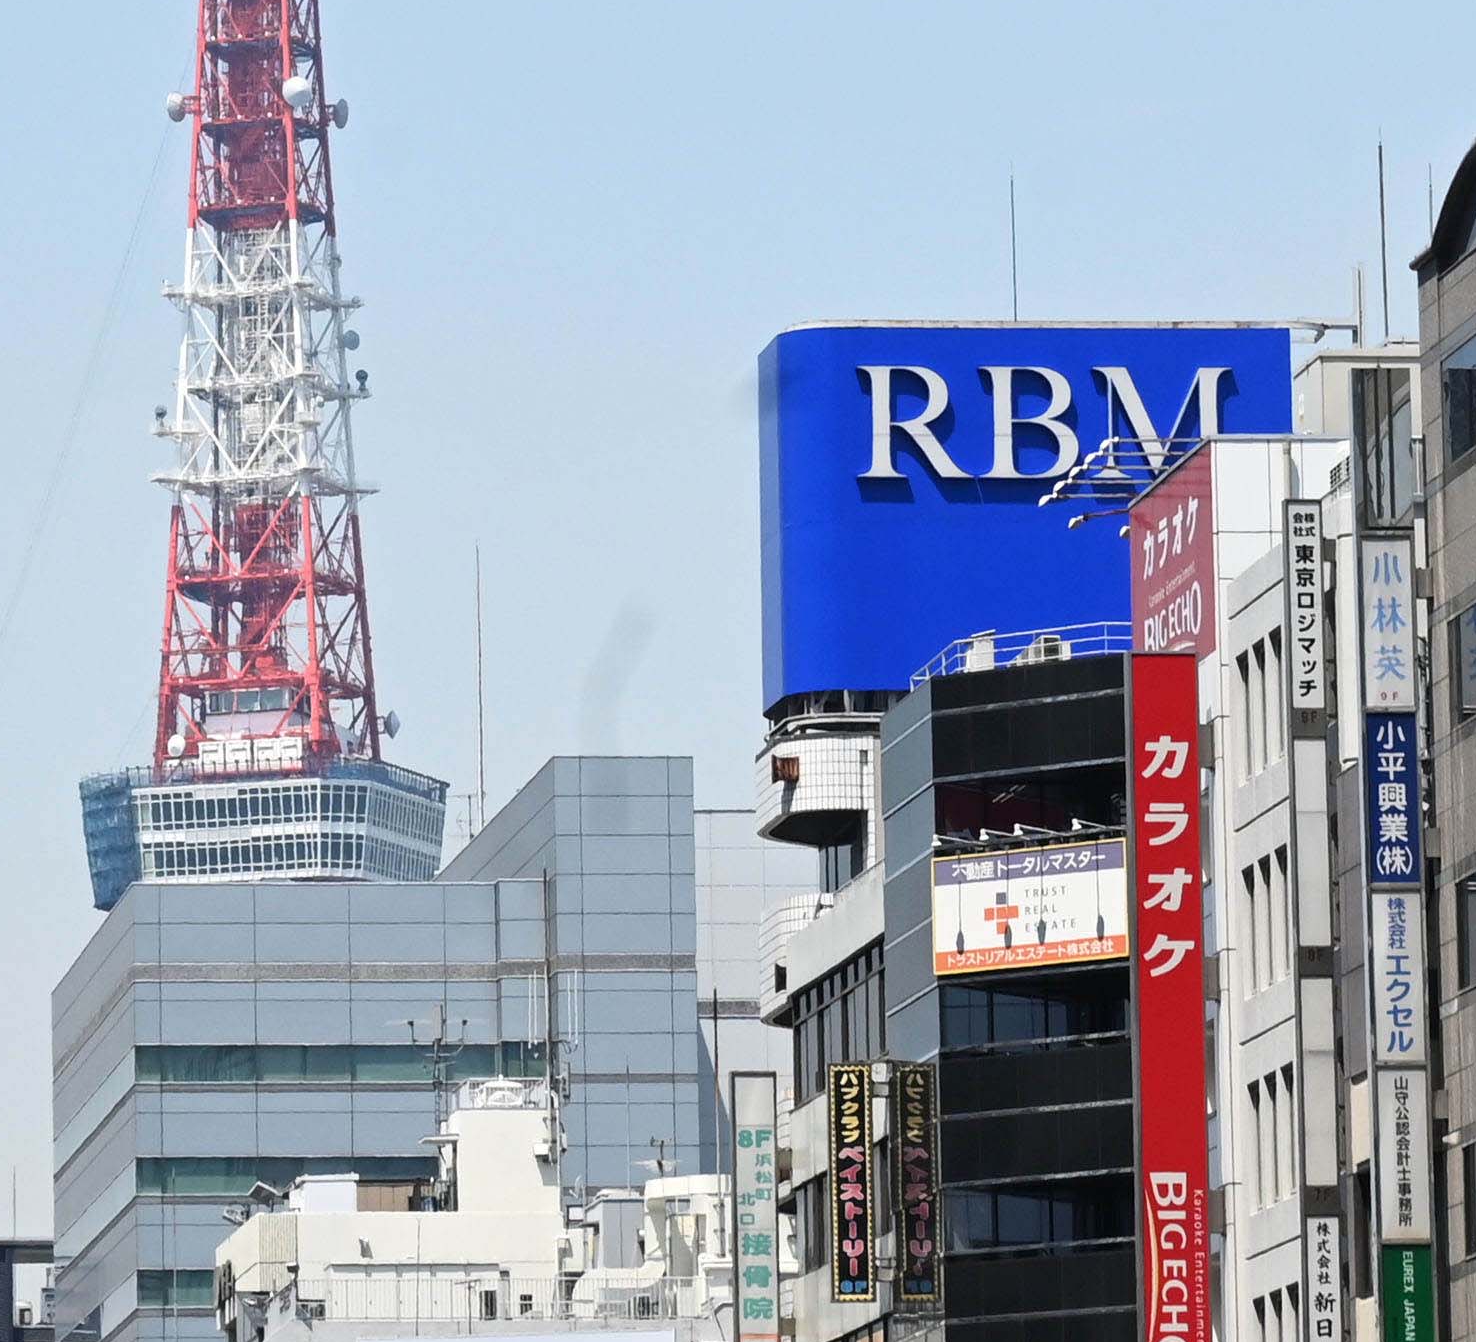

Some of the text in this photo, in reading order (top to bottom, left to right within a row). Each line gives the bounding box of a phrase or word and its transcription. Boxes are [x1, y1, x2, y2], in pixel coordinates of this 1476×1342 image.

[855, 365, 1235, 479] RBM
[1143, 496, 1199, 581] カラオケ
[1169, 580, 1201, 639] ECHO
[1295, 544, 1317, 697] 東京ロジマッチ
[1376, 721, 1413, 876] 小平興業(株)
[952, 850, 1106, 880] 不動産トータルマスター
[1143, 735, 1196, 977] カラオケ
[1025, 885, 1066, 898] TRUST
[1025, 903, 1059, 915] REAL
[947, 940, 1114, 967] トラストリアルエステート株式会社
[1386, 955, 1414, 1053] エクセル
[738, 1130, 772, 1148] 8F
[1394, 1077, 1412, 1227] 山守公認会計士事務所
[1149, 1171, 1188, 1251] BIG
[1193, 1189, 1204, 1245] Karaoke
[742, 1233, 773, 1319] 接骨院
[1316, 1221, 1331, 1285] 株式会社
[1402, 1251, 1415, 1294] EUREX
[1403, 1299, 1416, 1341] JAPAN
